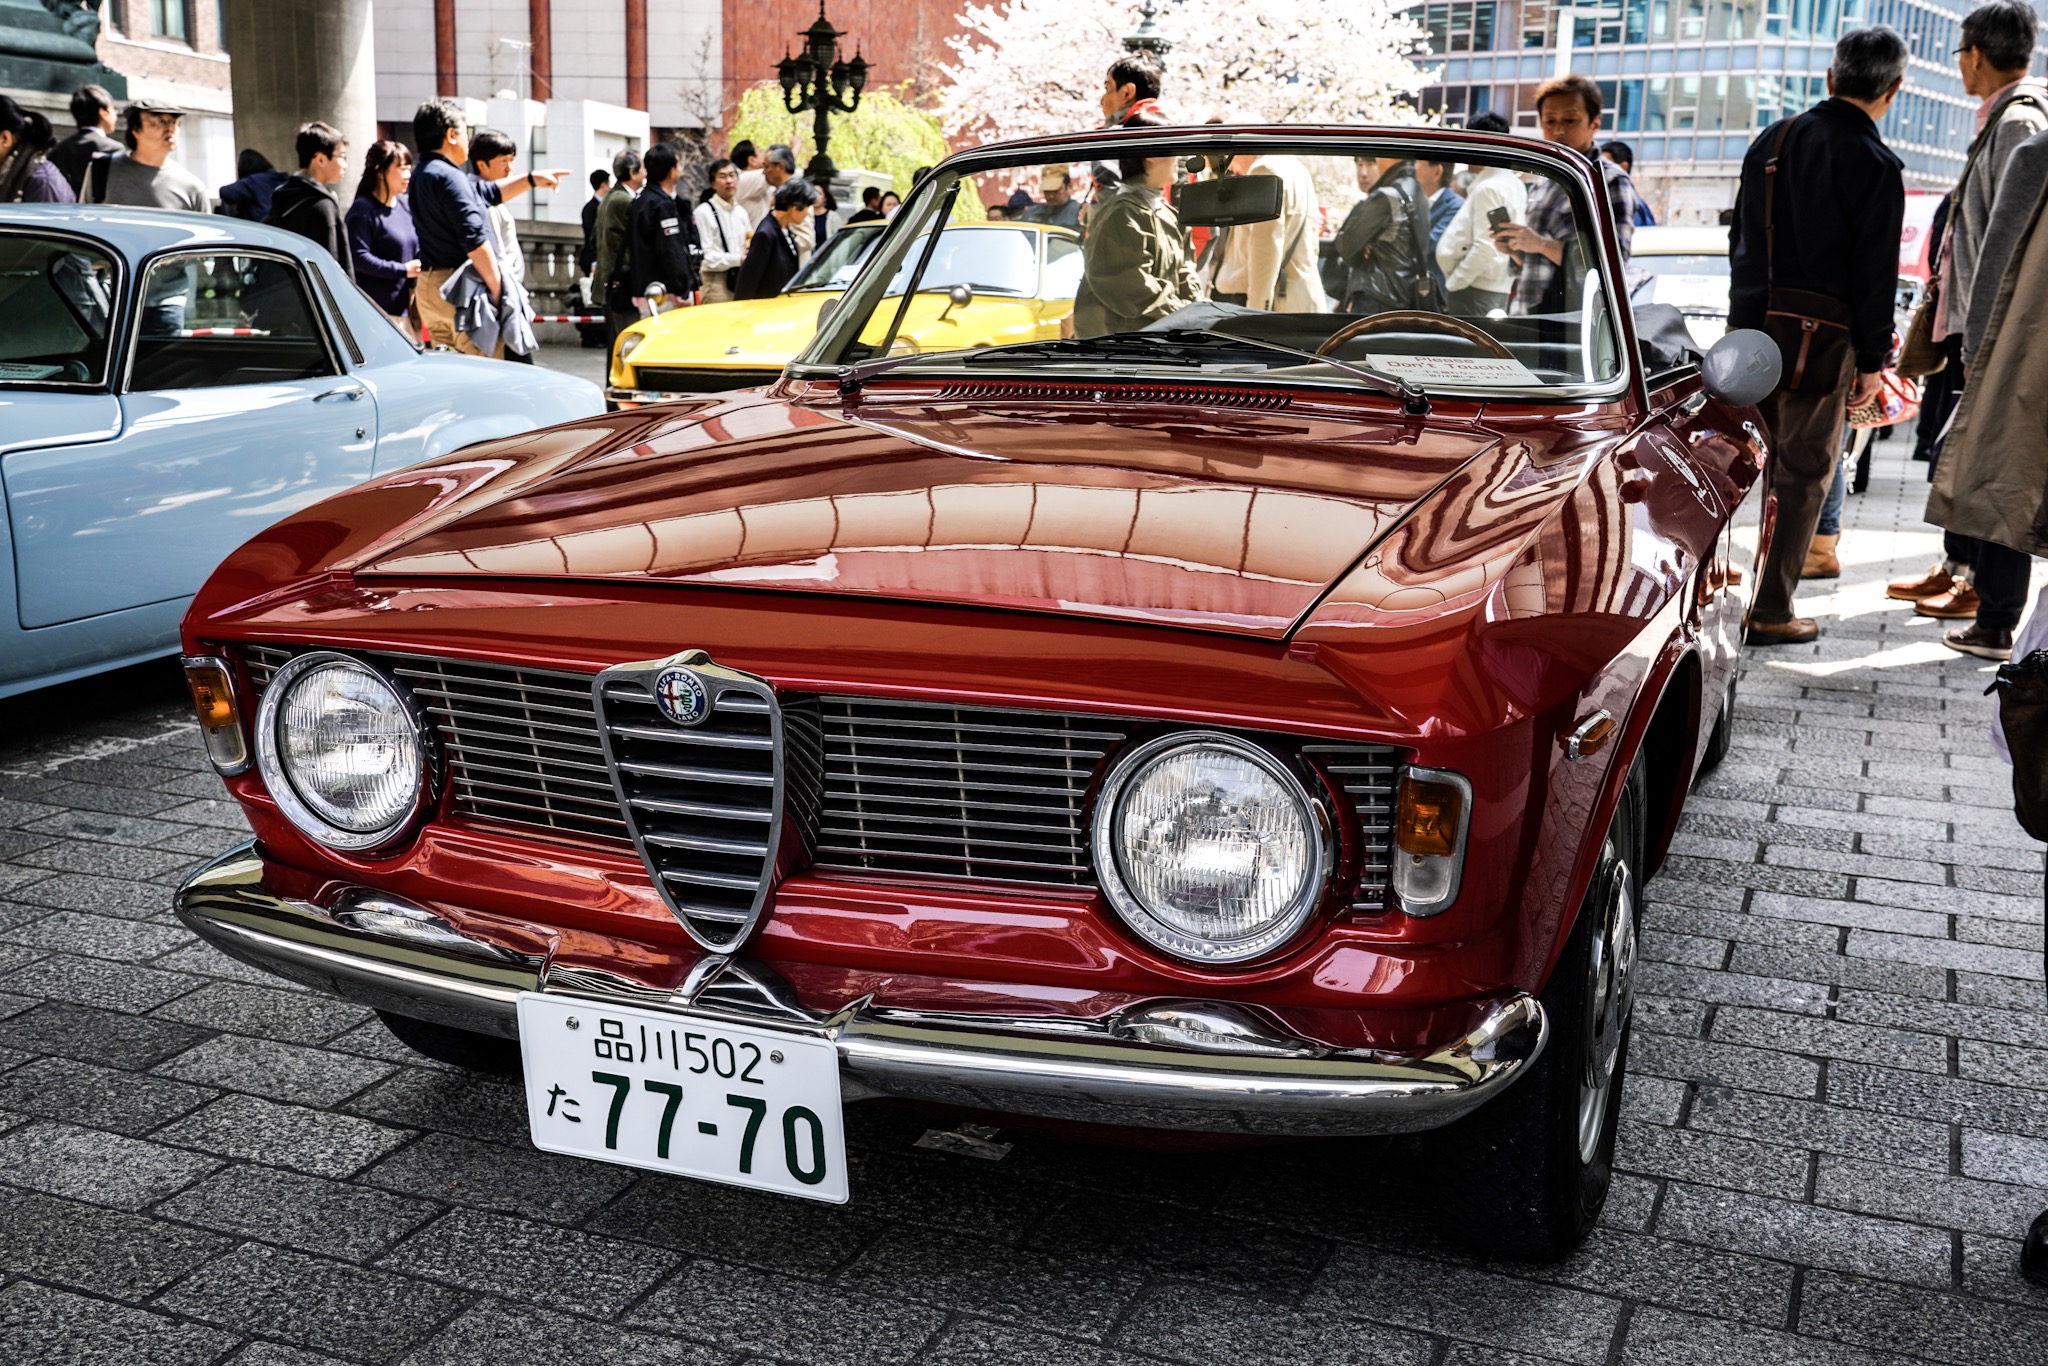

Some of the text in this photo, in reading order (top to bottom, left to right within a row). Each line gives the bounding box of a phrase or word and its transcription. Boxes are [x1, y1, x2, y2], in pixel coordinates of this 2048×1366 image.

[1414, 356, 1475, 364] Please
[1386, 361, 1513, 371] Don't Touch!!
[666, 709, 699, 721] MILANO
[547, 1070, 827, 1185] た 77-70
